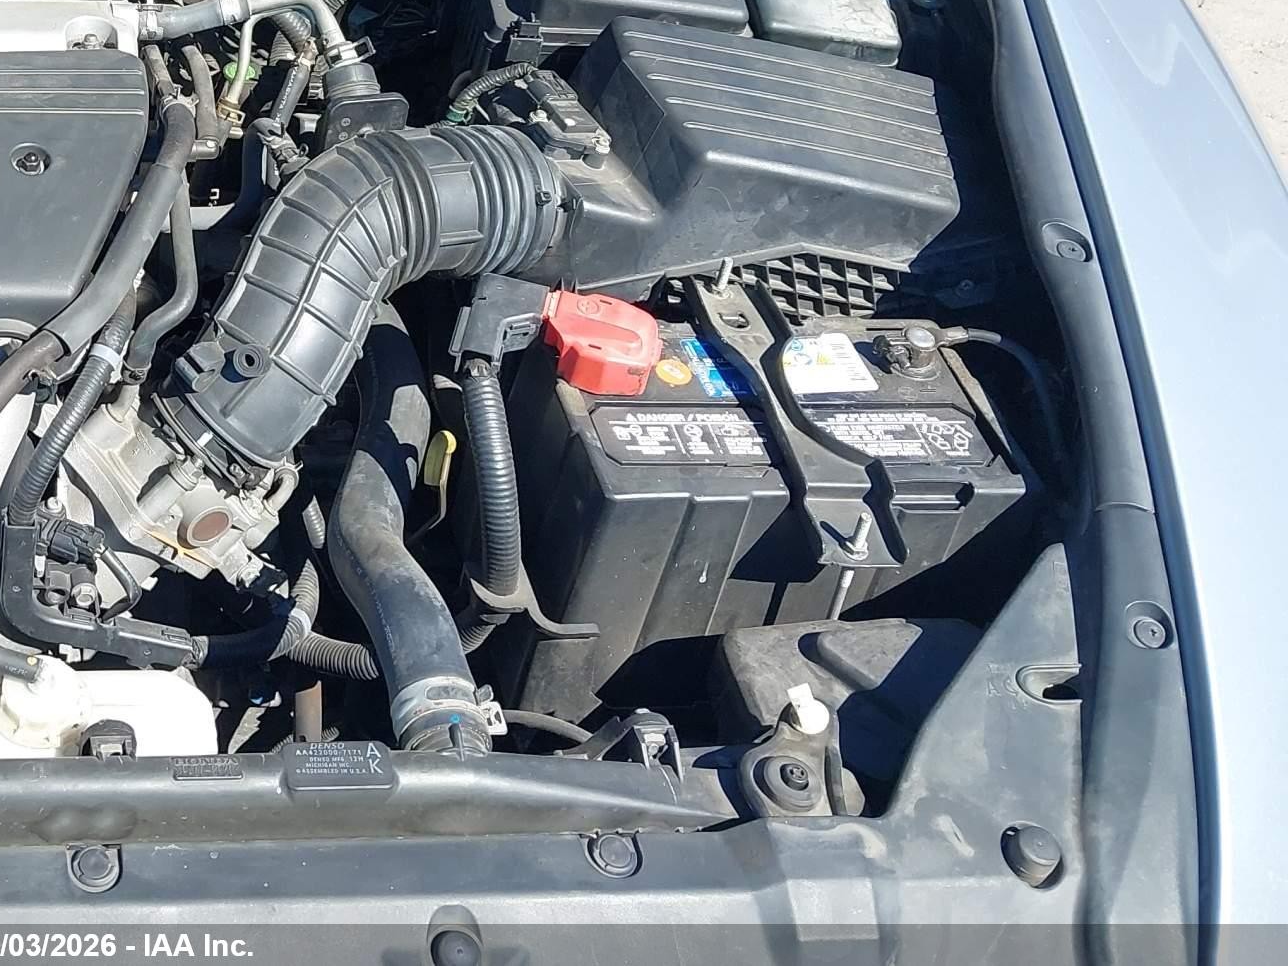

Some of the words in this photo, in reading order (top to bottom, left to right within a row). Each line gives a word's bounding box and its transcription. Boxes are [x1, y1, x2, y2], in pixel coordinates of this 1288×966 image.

[310, 742, 345, 750] DENSO
[366, 742, 382, 758] A
[368, 758, 384, 775] K
